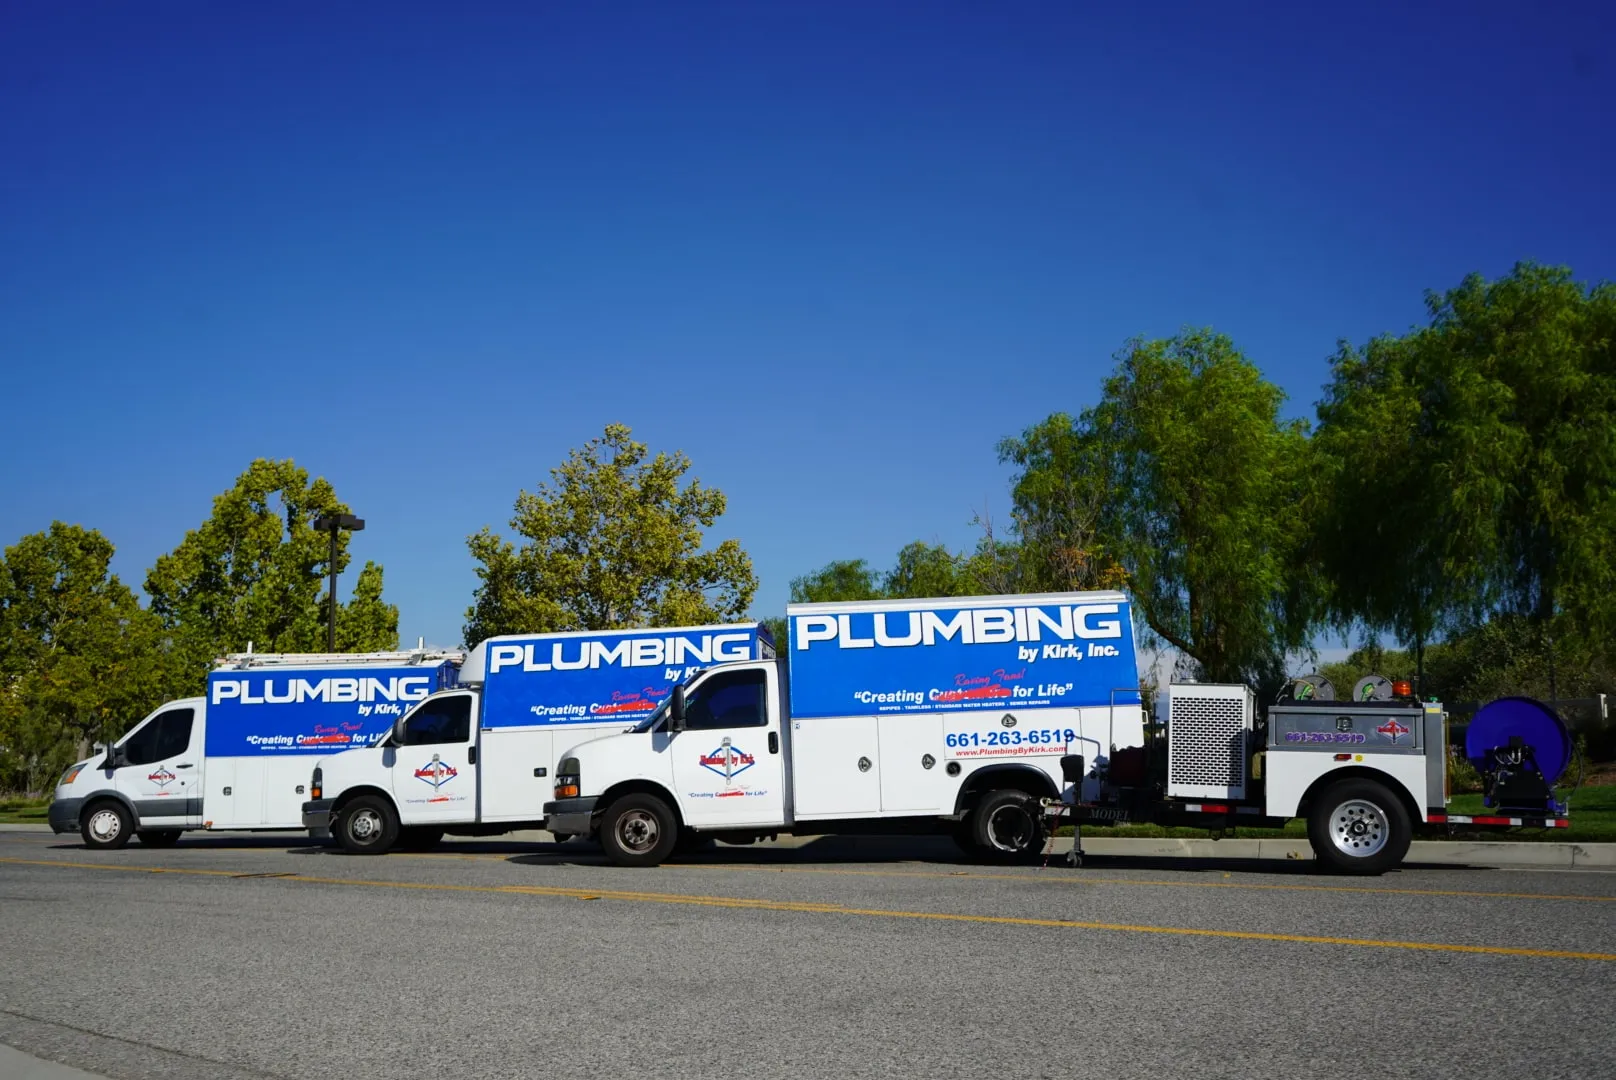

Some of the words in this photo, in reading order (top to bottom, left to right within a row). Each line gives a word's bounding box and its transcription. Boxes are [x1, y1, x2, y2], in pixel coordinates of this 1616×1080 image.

[796, 604, 1121, 650] PLUMBING
[490, 633, 750, 673] PLUMBING
[1018, 646, 1039, 663] by
[1042, 644, 1083, 661] Kirk,
[1088, 643, 1119, 657] Inc.
[664, 668, 682, 682] by
[954, 673, 990, 687] Raving
[212, 677, 429, 704] PLUMBING
[854, 689, 924, 704] “Creating
[1013, 685, 1036, 698] for
[1038, 683, 1073, 697] Life”
[358, 704, 373, 716] by
[374, 703, 401, 716] Kirk,
[531, 704, 586, 716] “Creating
[247, 735, 293, 746] “Creating
[352, 733, 368, 743] for
[946, 729, 1075, 747] 661-263-6519
[956, 746, 1067, 756] www.PlumbingByKirk.com
